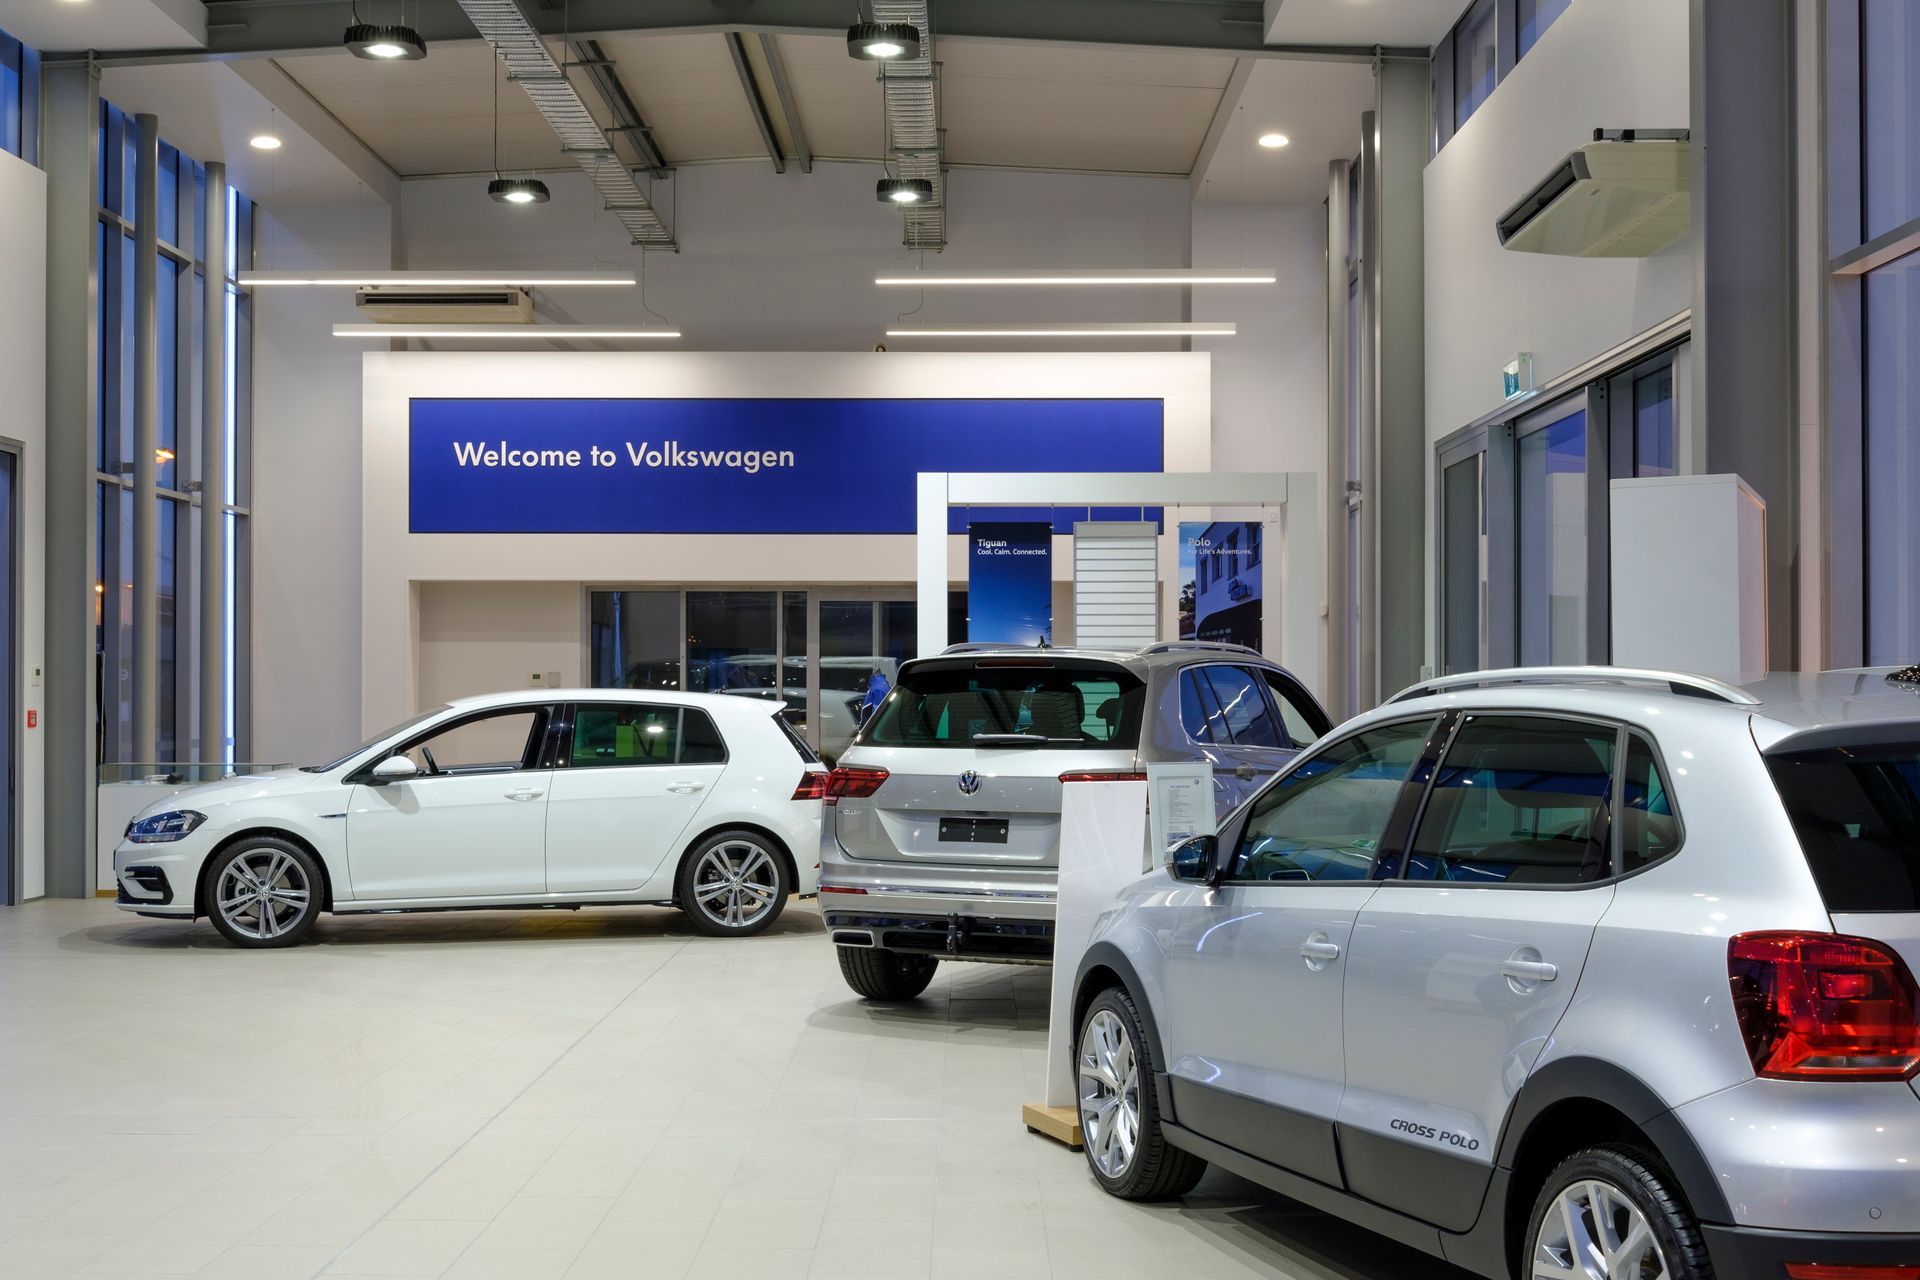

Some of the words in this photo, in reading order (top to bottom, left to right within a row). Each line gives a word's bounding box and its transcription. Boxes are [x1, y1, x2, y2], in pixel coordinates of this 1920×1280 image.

[453, 440, 581, 467] Welcome
[591, 445, 617, 467] to
[625, 440, 795, 474] Volkswagen
[977, 538, 1007, 549] Tiguan
[1188, 537, 1211, 546] Polo
[1390, 1118, 1437, 1139] CROSS
[1438, 1130, 1480, 1151] POLO
